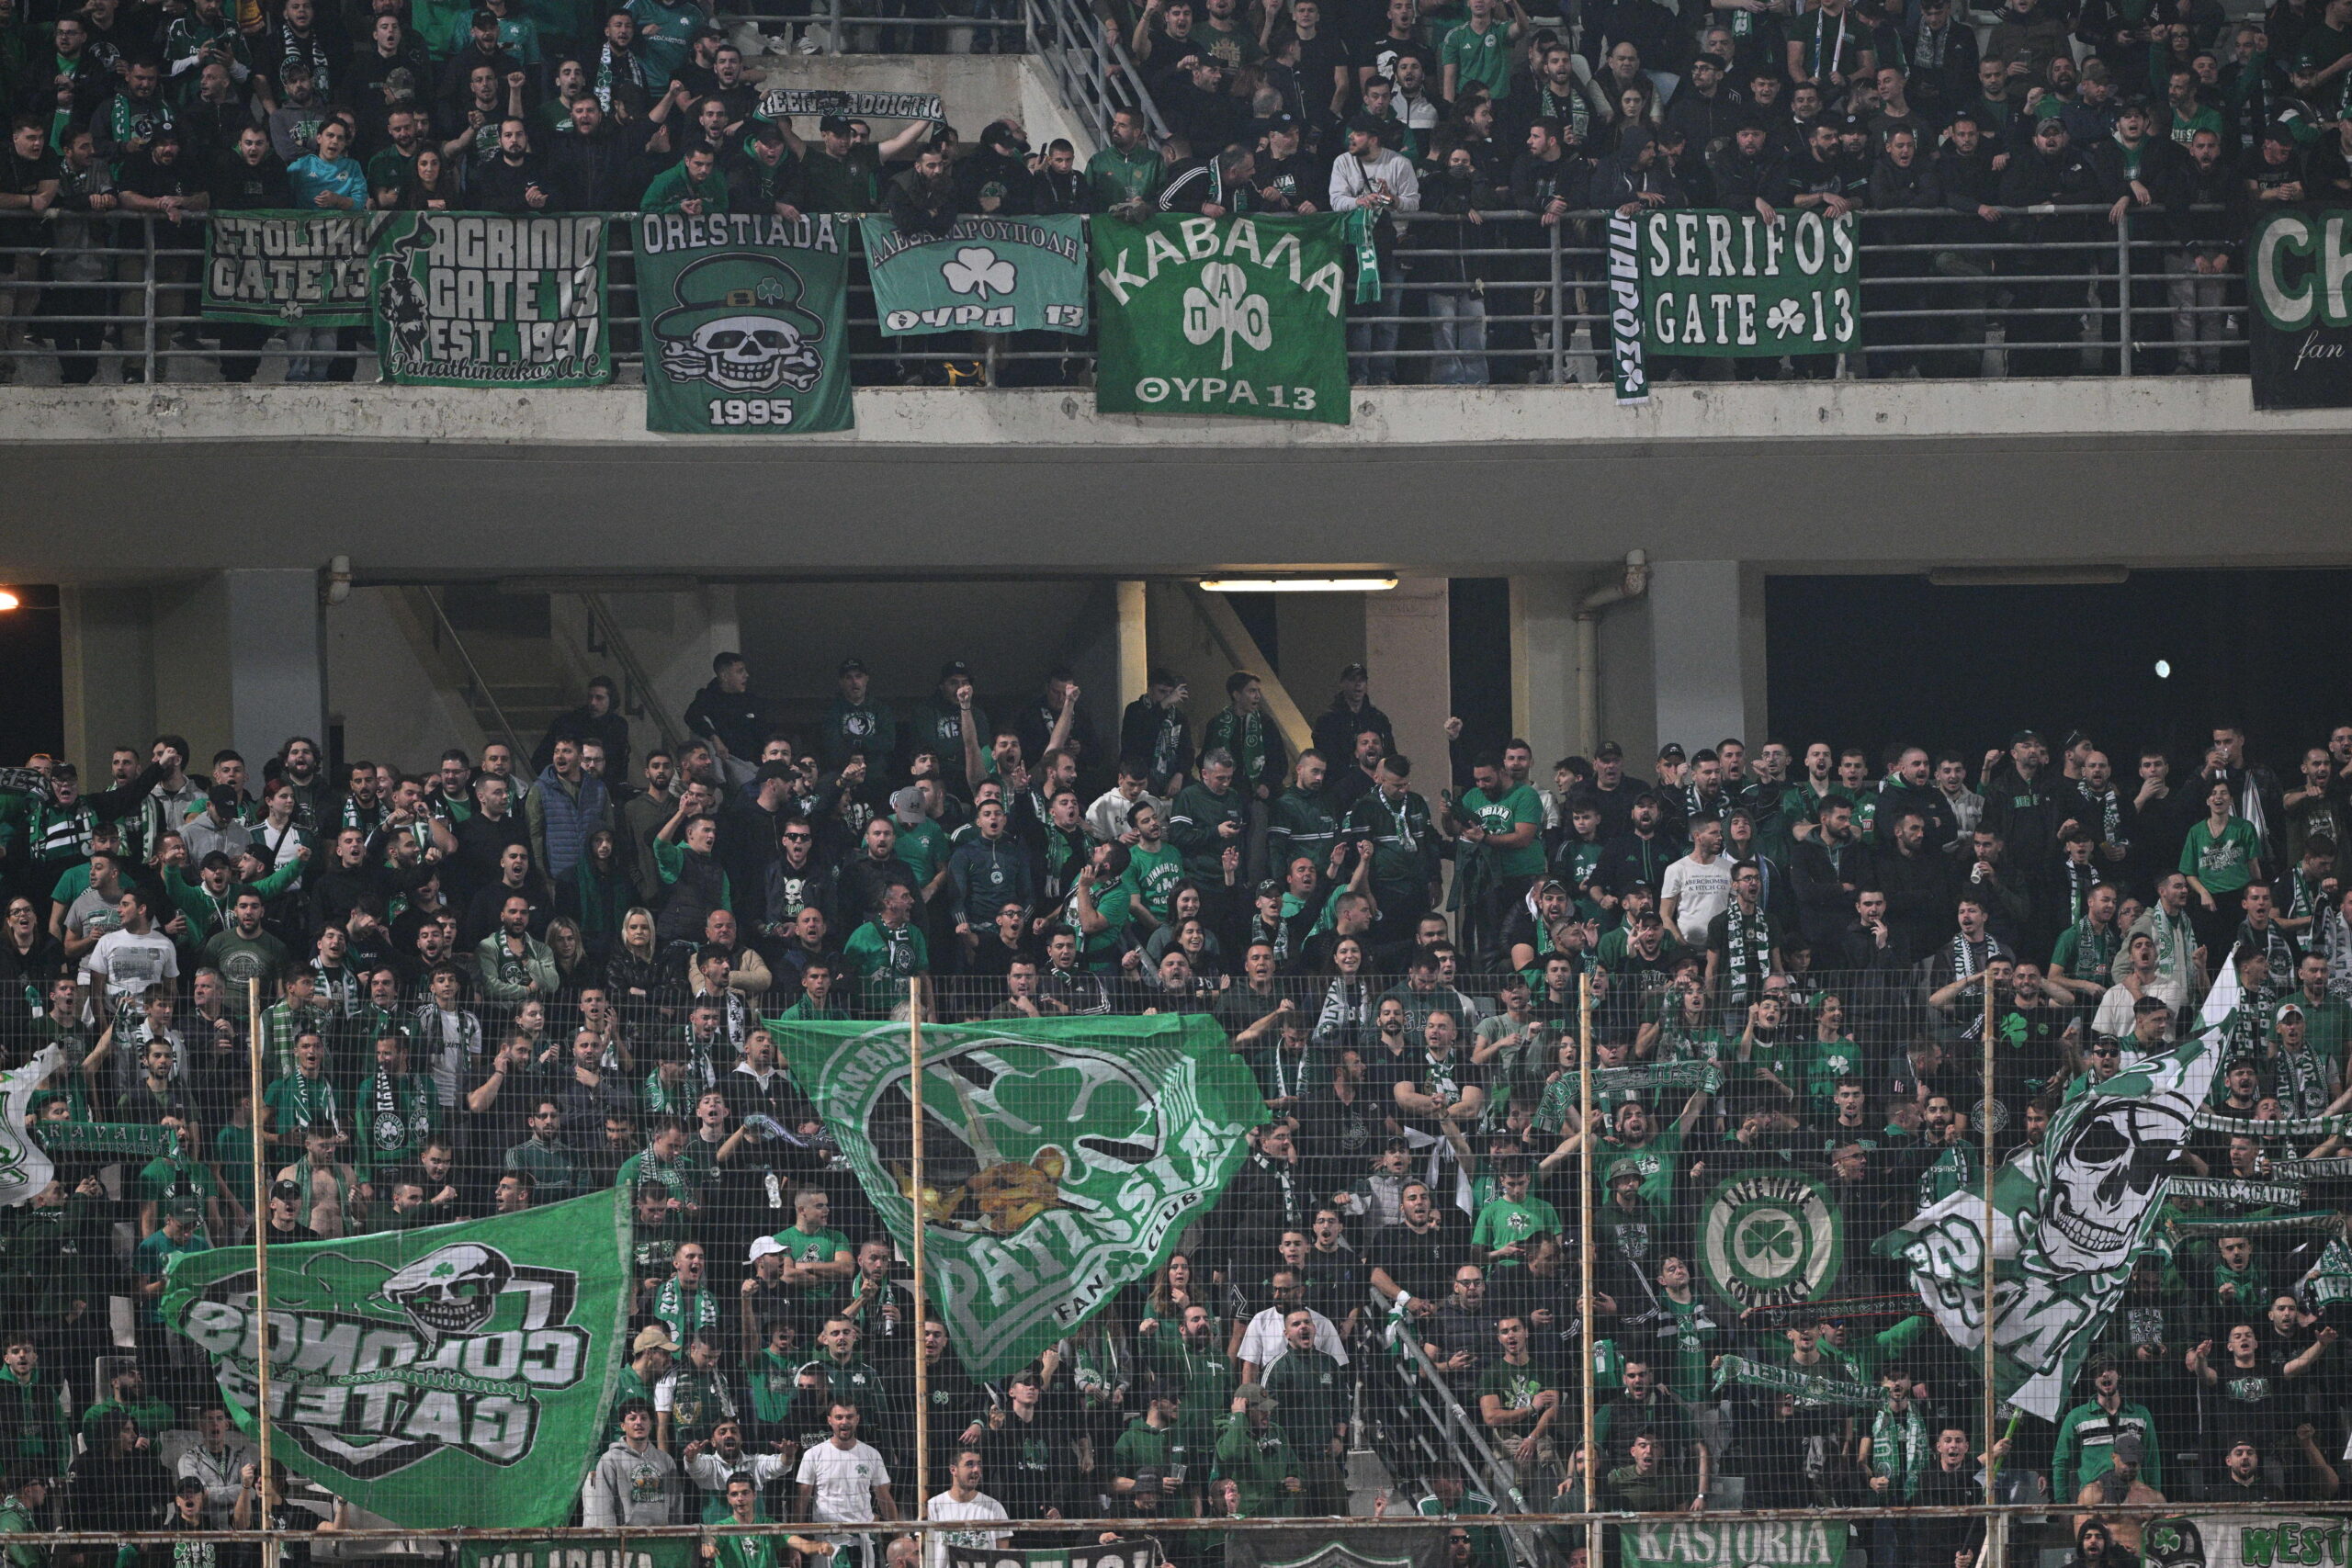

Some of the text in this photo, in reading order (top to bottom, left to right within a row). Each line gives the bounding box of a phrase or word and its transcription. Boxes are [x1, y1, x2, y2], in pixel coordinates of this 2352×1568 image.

[429, 216, 602, 269] AGRINIO
[643, 212, 840, 255] ORESTIADA
[1648, 210, 1854, 277] SERIFOS
[212, 258, 369, 301] GATE 13
[1098, 216, 1344, 318] ΚΑΒΑΛΑ
[429, 265, 599, 321] GATE 13
[1609, 216, 1643, 365] ΠΑΡΟΣ
[1044, 304, 1084, 327] 13
[1655, 287, 1854, 345] GATE 13
[429, 317, 599, 364] EST. 1997
[2293, 329, 2346, 371] fan
[389, 350, 607, 382] Panathinaikos A.C.
[708, 398, 794, 426] 1995
[1135, 377, 1317, 411] ΘΥΡΑ 13
[49, 1123, 171, 1143] KAVALA
[2194, 1111, 2324, 1136] UMENITSA
[1723, 1175, 1816, 1211] LIFETIME
[922, 1117, 1220, 1328] PATISSIA
[1054, 1193, 1198, 1324] FAN CLUB
[1724, 1274, 1815, 1306] CONTRACT
[1637, 1520, 1832, 1564] KASTORIA
[2241, 1522, 2345, 1568] WEST
